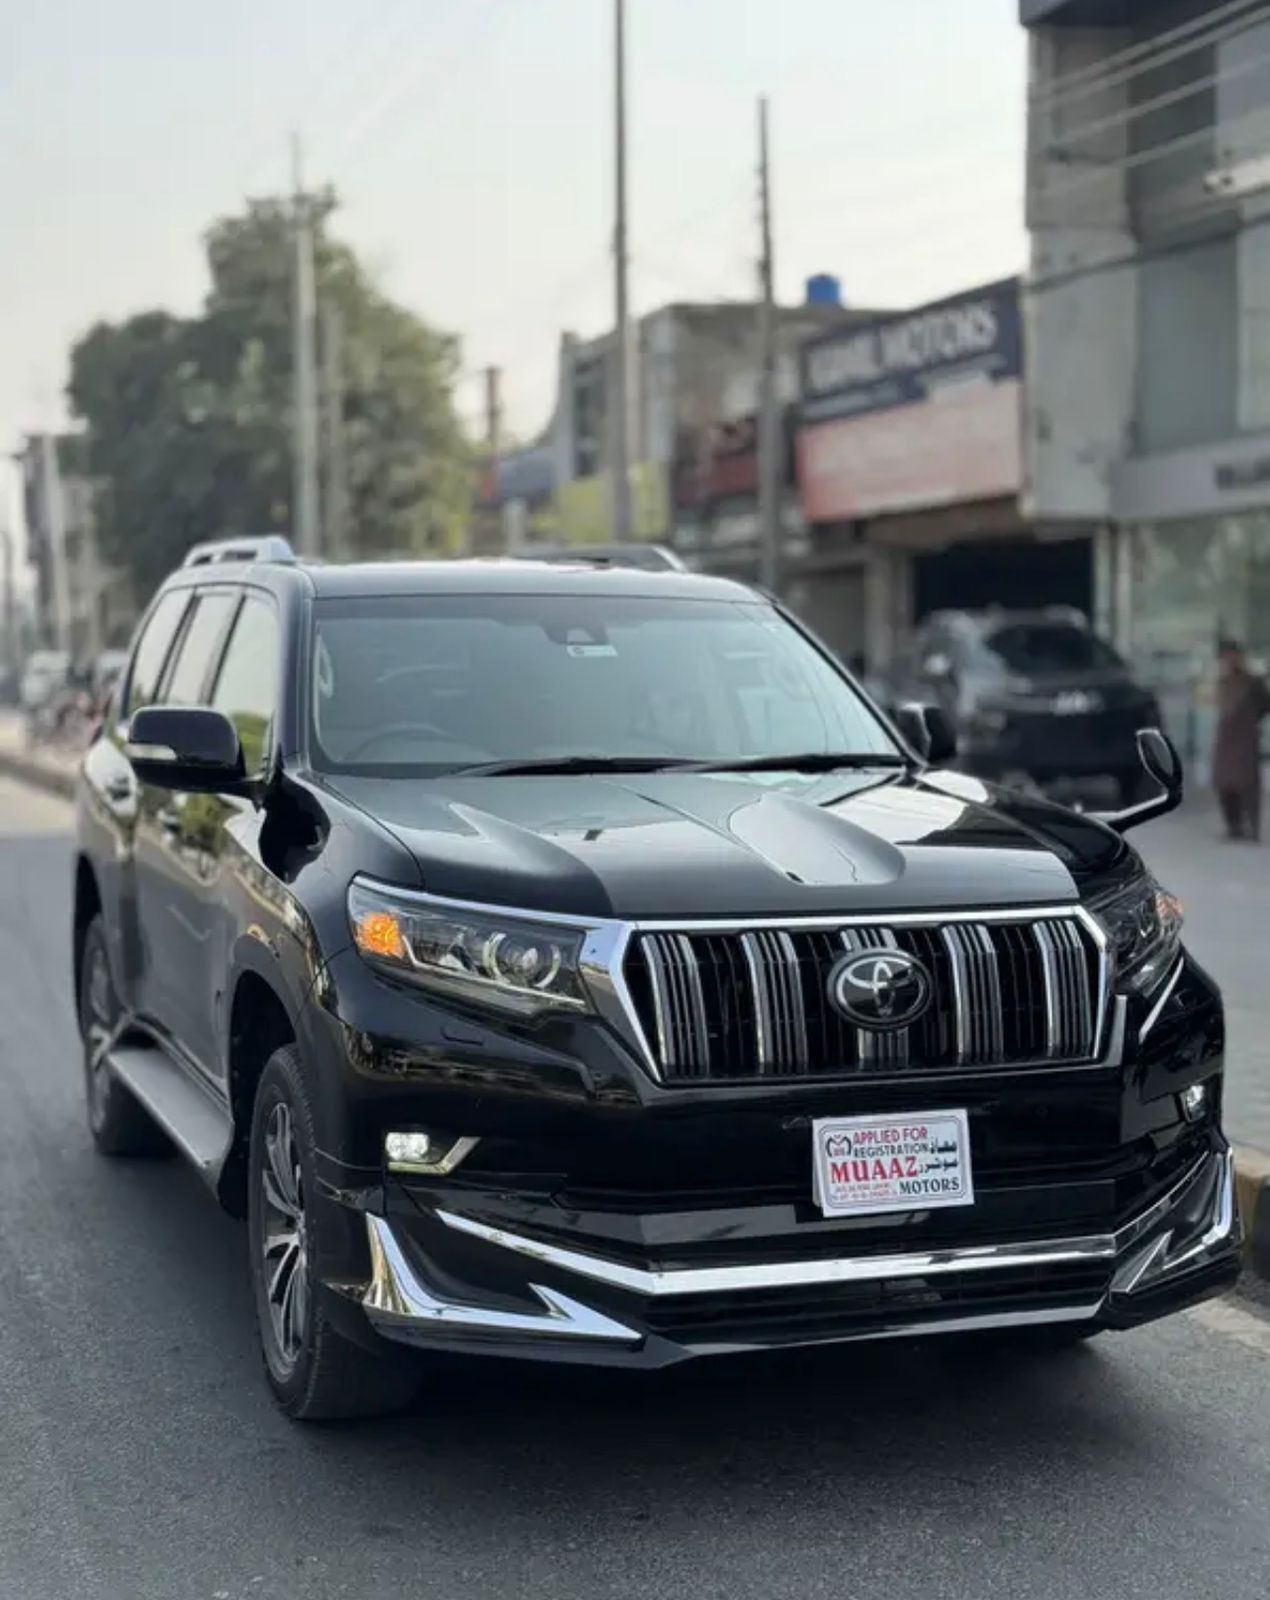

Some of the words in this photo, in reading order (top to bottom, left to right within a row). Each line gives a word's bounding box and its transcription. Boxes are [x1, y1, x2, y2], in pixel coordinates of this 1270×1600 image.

[853, 1129, 900, 1144] APPLIED
[903, 1126, 928, 1141] FOR
[854, 1144, 929, 1158] REGISTRATION
[831, 1156, 919, 1184] MUAAZ
[899, 1178, 959, 1194] MOTORS
